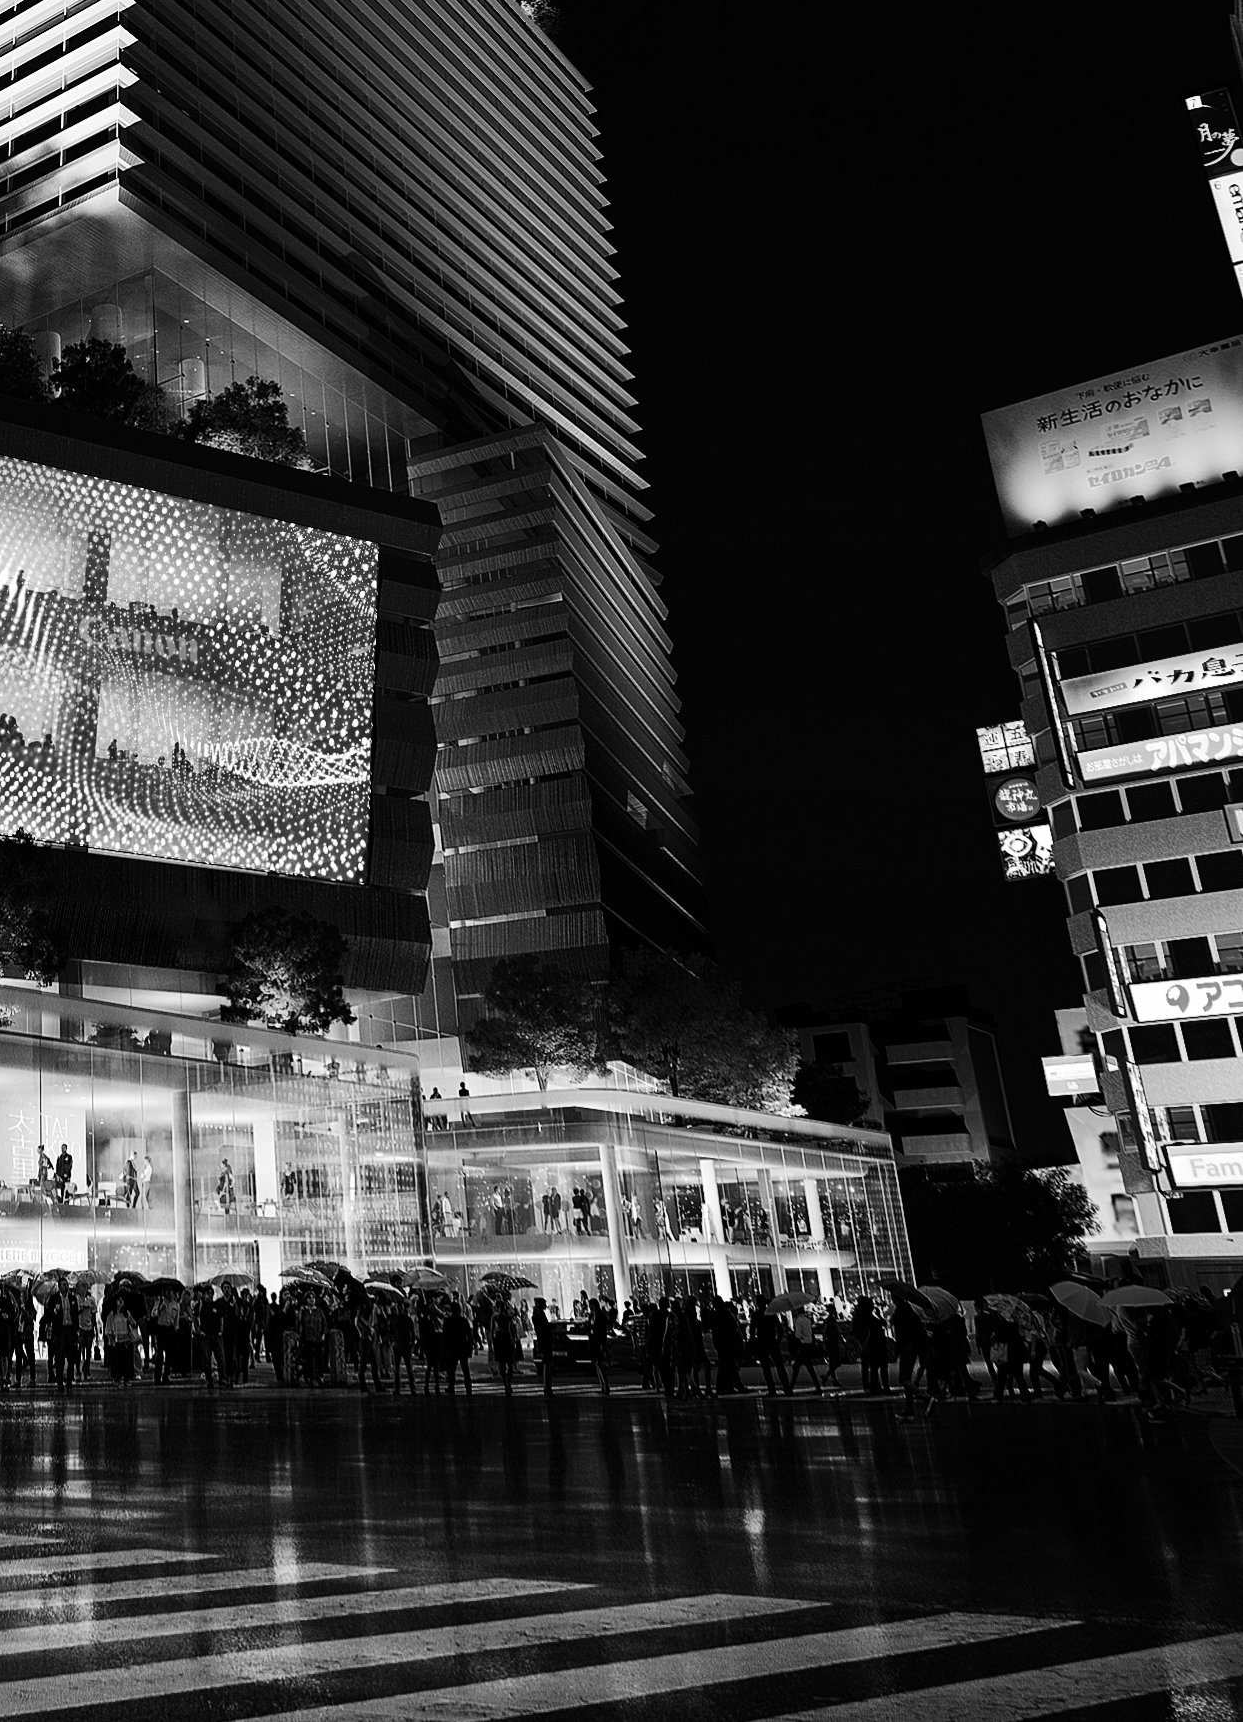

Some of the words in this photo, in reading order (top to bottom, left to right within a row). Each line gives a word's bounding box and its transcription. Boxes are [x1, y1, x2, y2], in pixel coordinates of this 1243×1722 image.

[1036, 376, 1204, 433] 新生活のおなかに
[79, 616, 198, 664] Canon
[1196, 980, 1243, 1012] アコ
